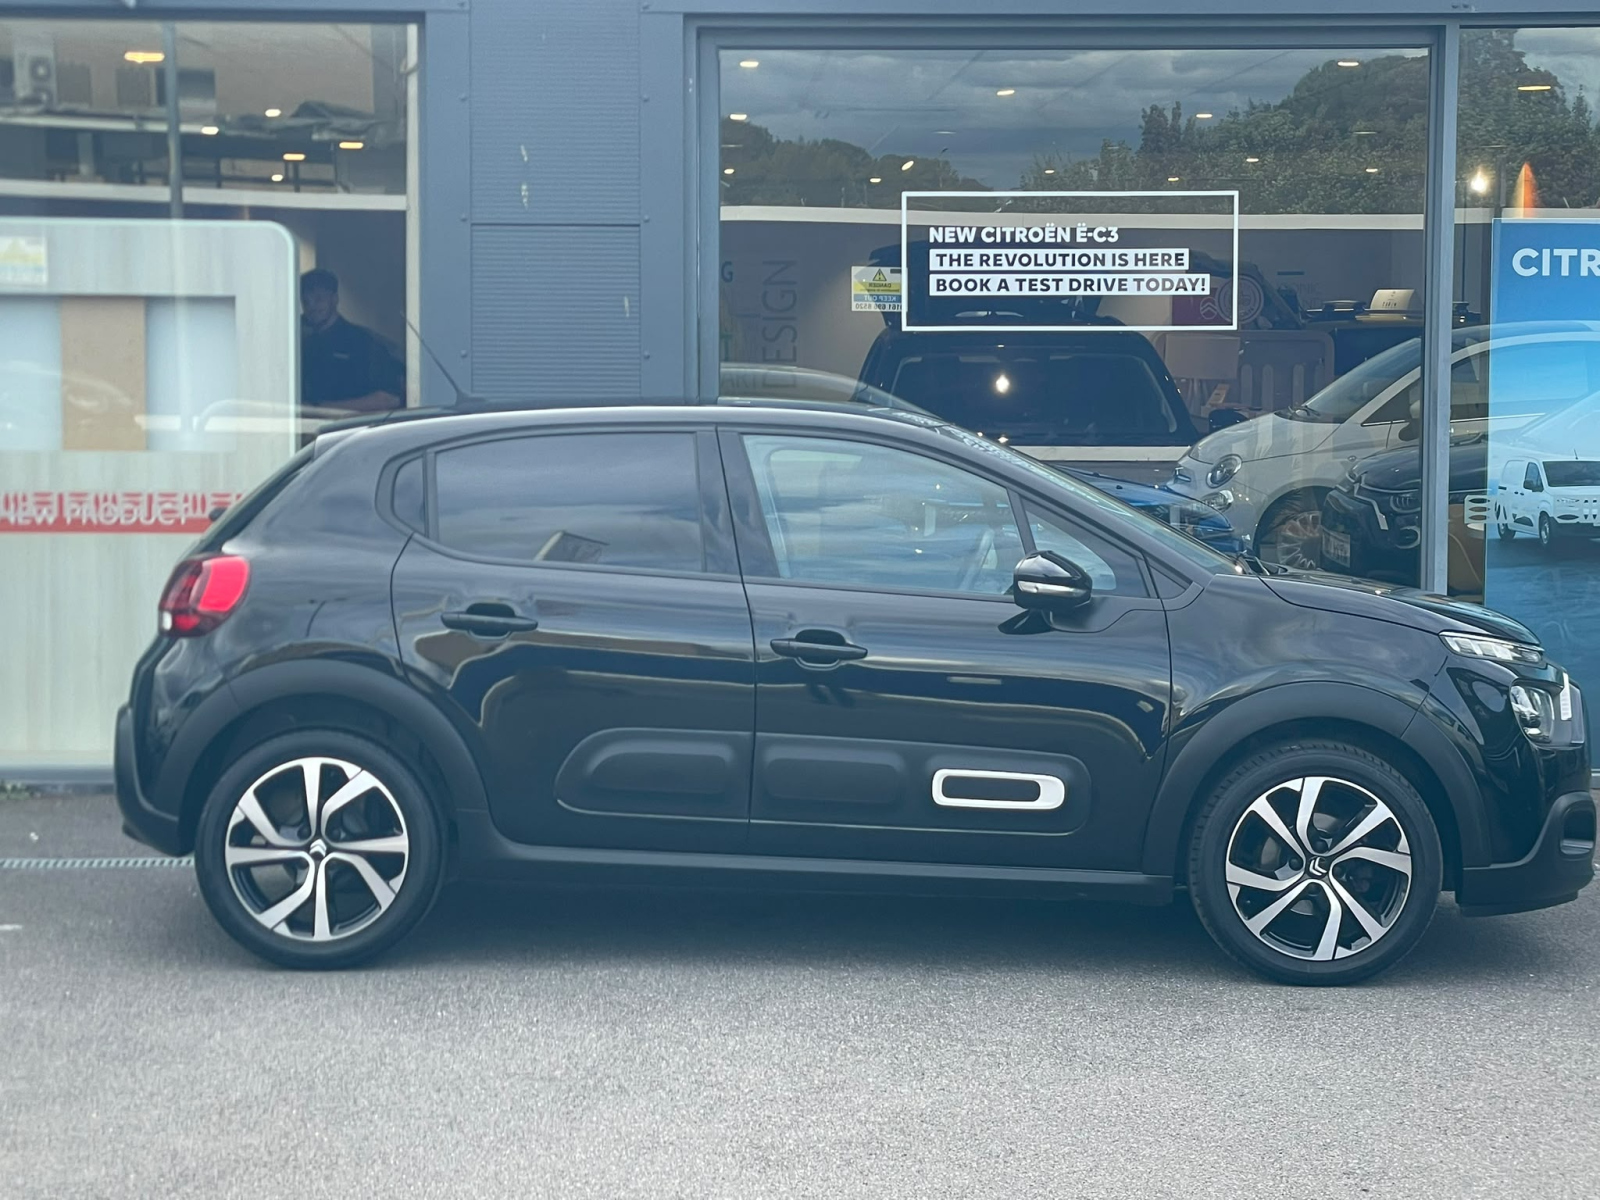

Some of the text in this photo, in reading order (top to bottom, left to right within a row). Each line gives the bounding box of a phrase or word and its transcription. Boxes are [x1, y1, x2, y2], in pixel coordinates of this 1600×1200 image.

[929, 222, 1119, 243] NEW CITROËN Ë-C3
[936, 252, 1185, 267] THE REVOLUTION IS HERE
[1512, 247, 1600, 277] CITR
[936, 277, 1206, 292] BOOK A TEST DRIVE TODAY!
